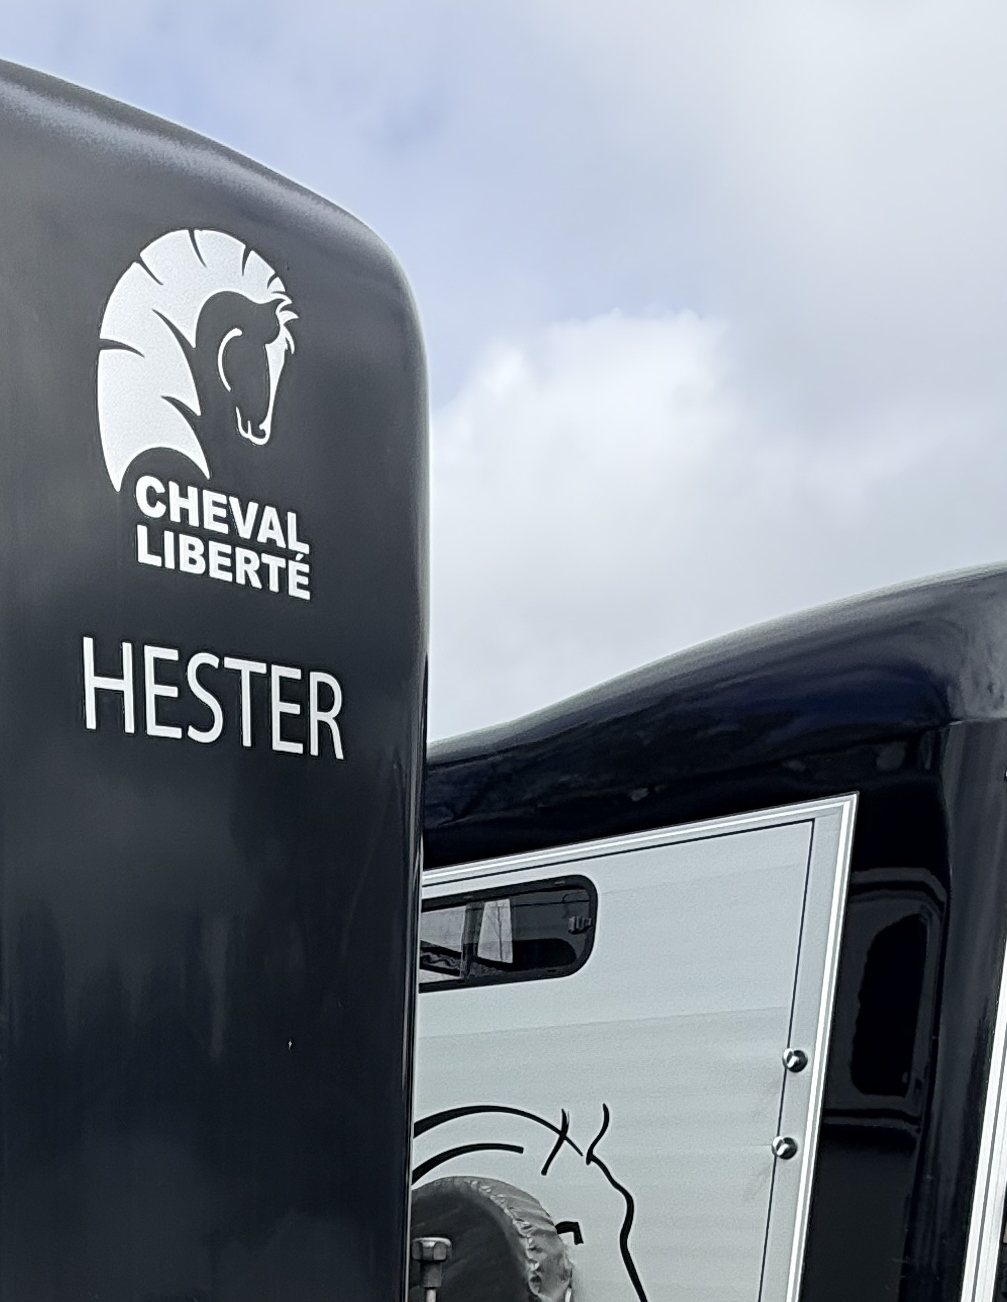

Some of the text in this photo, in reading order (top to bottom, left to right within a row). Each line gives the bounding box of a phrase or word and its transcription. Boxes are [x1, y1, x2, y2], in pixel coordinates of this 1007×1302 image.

[135, 475, 310, 554] CHEVAL
[136, 524, 311, 600] LIBERTÉ
[82, 636, 344, 760] HESTER
